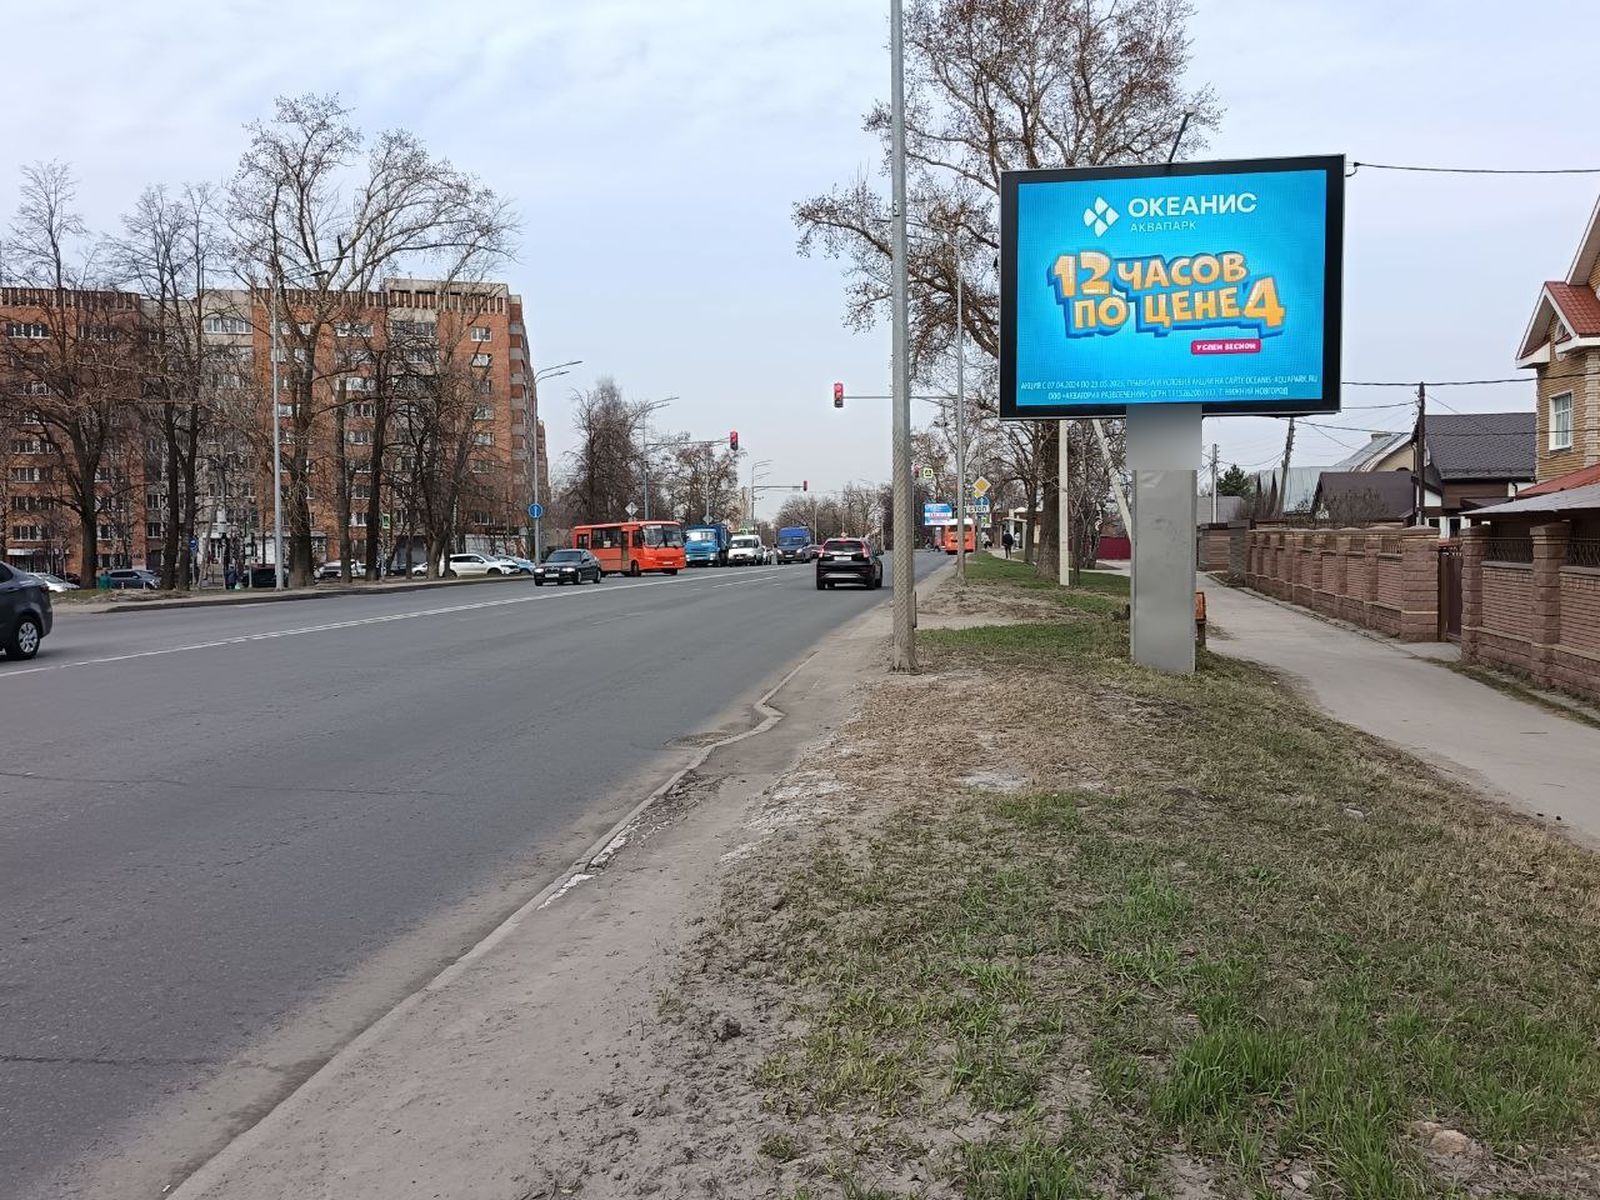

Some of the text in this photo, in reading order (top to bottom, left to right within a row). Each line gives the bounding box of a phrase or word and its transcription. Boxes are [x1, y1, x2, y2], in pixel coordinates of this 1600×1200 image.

[1128, 192, 1257, 218] ОКЕАНИС
[1130, 221, 1196, 233] АКВАПАРК
[1054, 252, 1247, 298] 12 ЧАСОВ
[1074, 277, 1285, 329] ПО ЦЕНЕ 4
